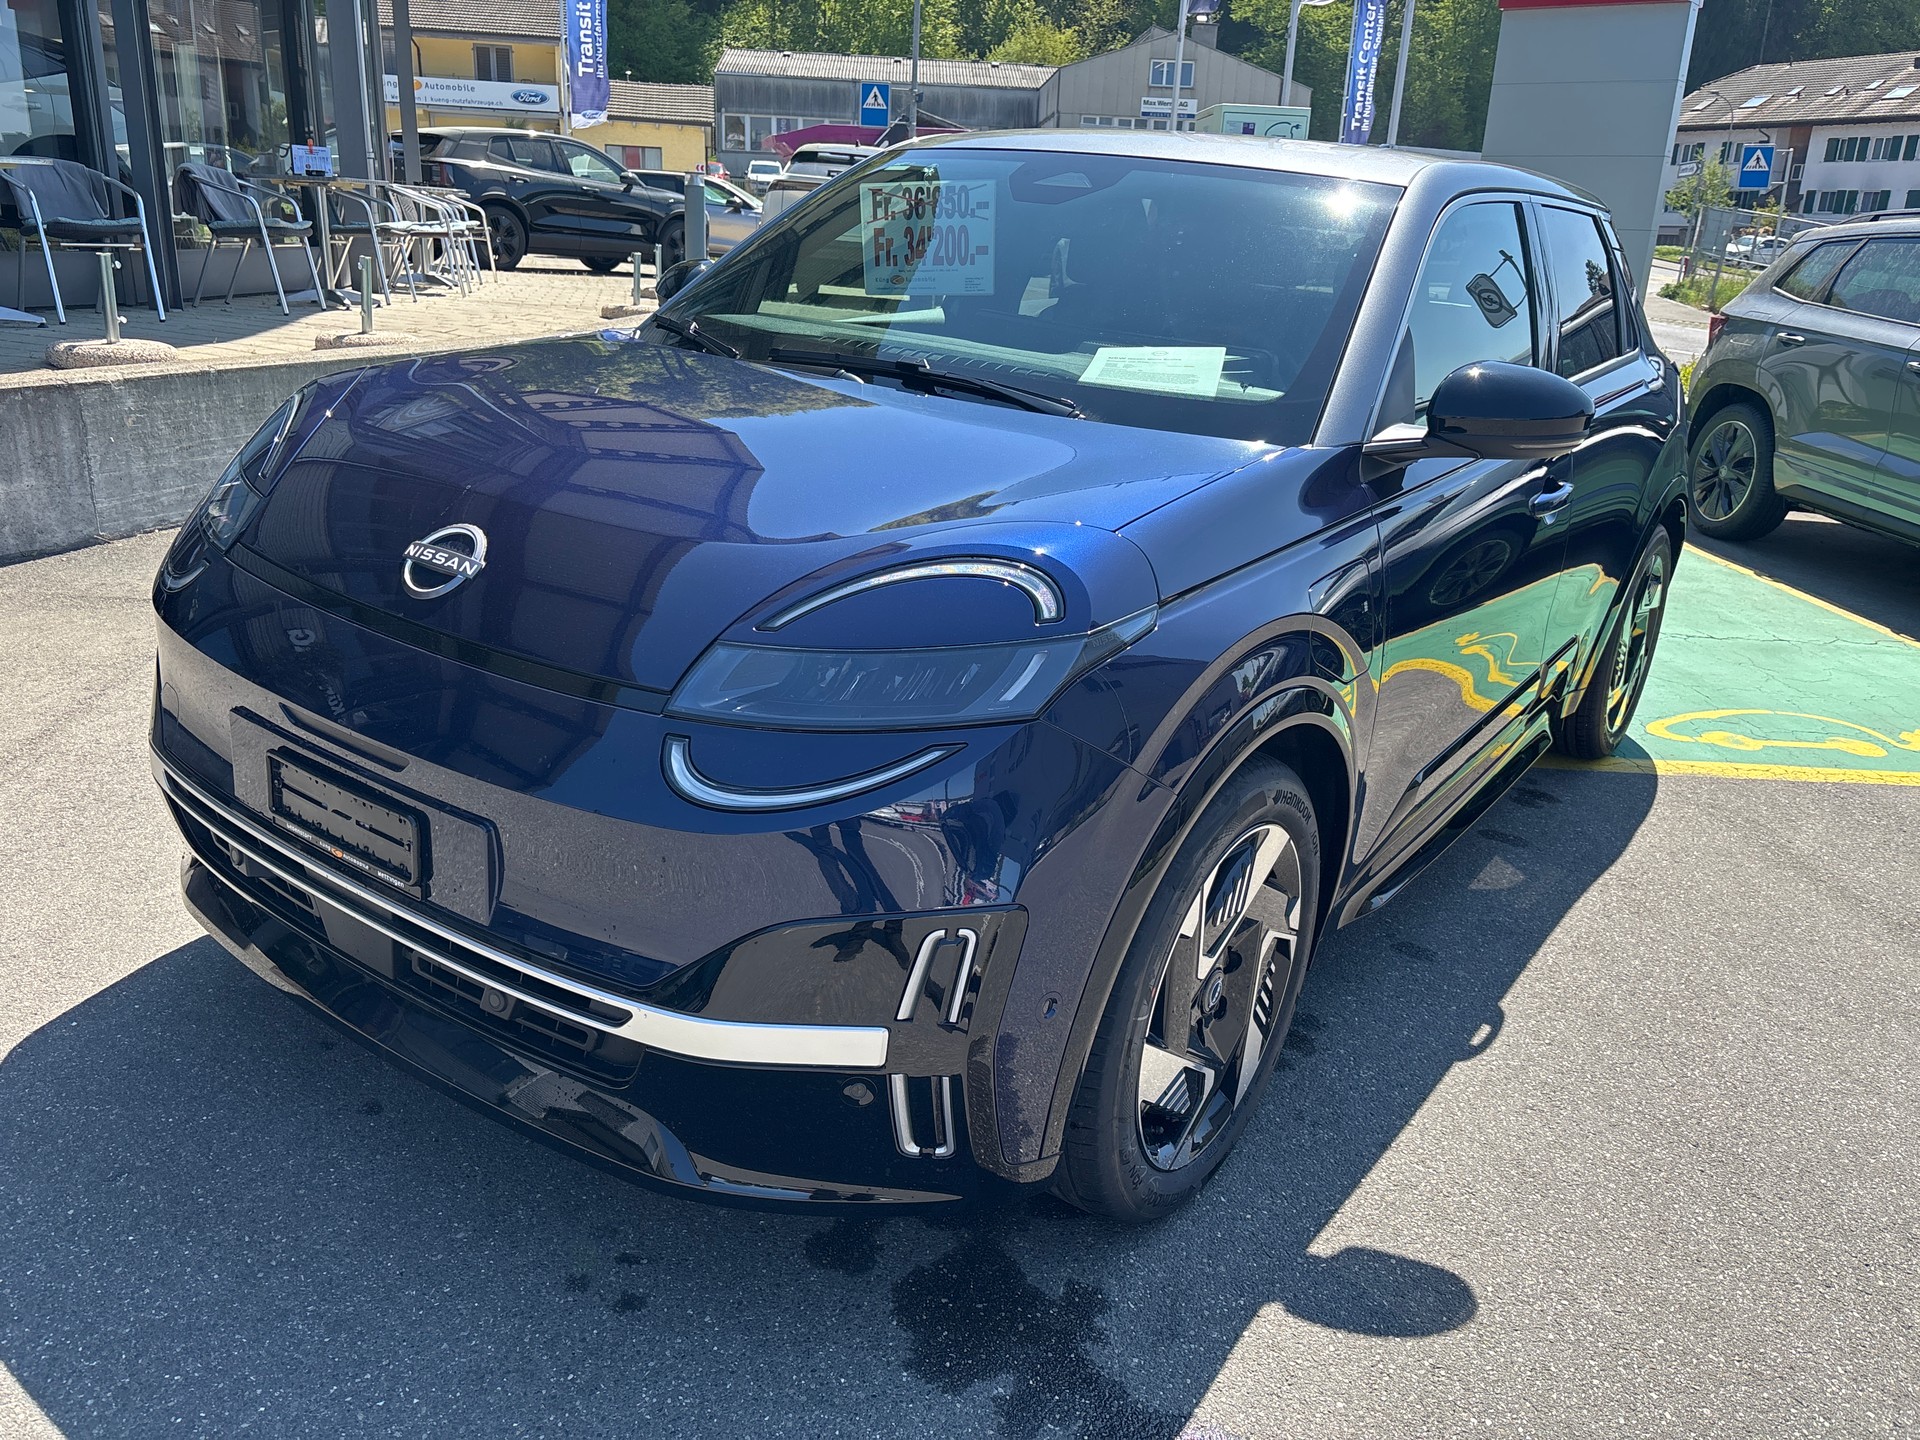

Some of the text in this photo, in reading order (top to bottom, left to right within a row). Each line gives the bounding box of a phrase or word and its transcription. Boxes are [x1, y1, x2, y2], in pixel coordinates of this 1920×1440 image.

[575, 2, 594, 77] Transit
[596, 66, 605, 79] Ihr
[1351, 2, 1377, 131] Transit Center
[424, 81, 476, 92] Automobile
[1361, 118, 1370, 131] Ihr
[871, 188, 896, 221] Fr.
[873, 227, 898, 267] Fr.
[404, 544, 478, 576] NISSAN
[377, 870, 405, 889] Wettingen
